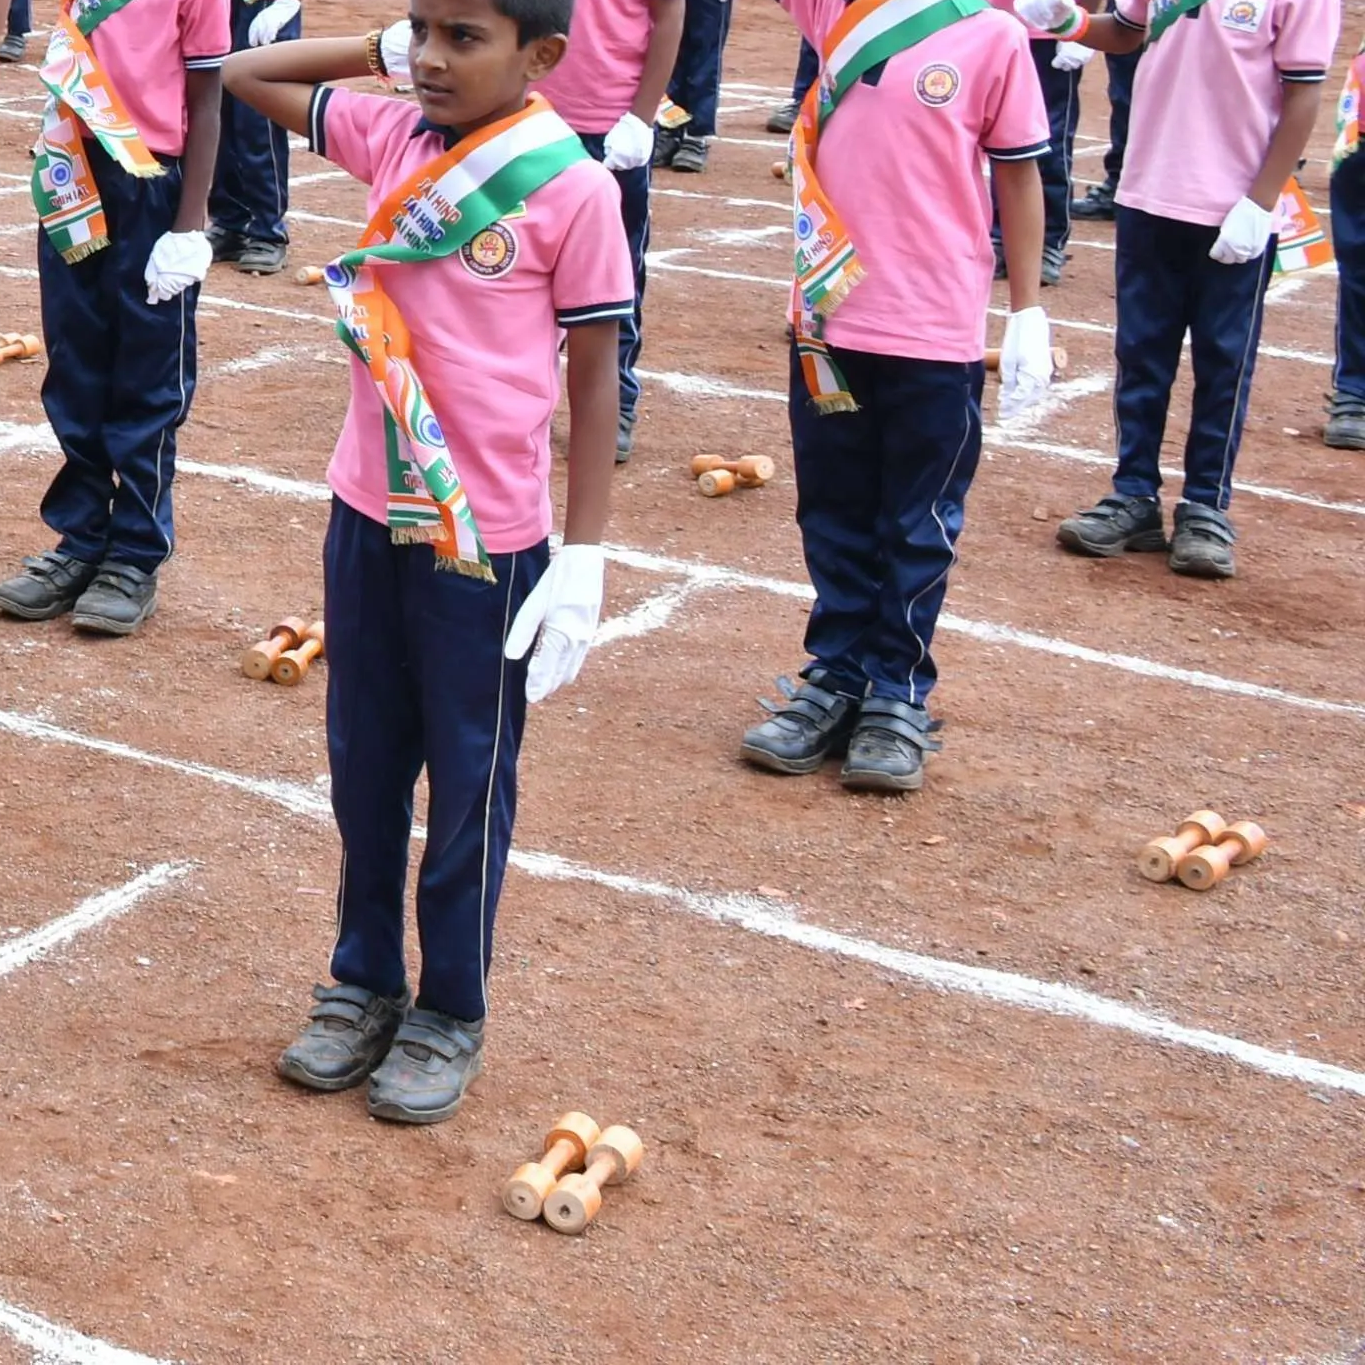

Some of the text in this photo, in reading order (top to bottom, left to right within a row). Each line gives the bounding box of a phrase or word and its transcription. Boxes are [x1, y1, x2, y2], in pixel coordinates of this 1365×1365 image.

[402, 196, 446, 243] JAI HIND
[418, 178, 462, 224] JAI HIND
[811, 232, 834, 255] HIND
